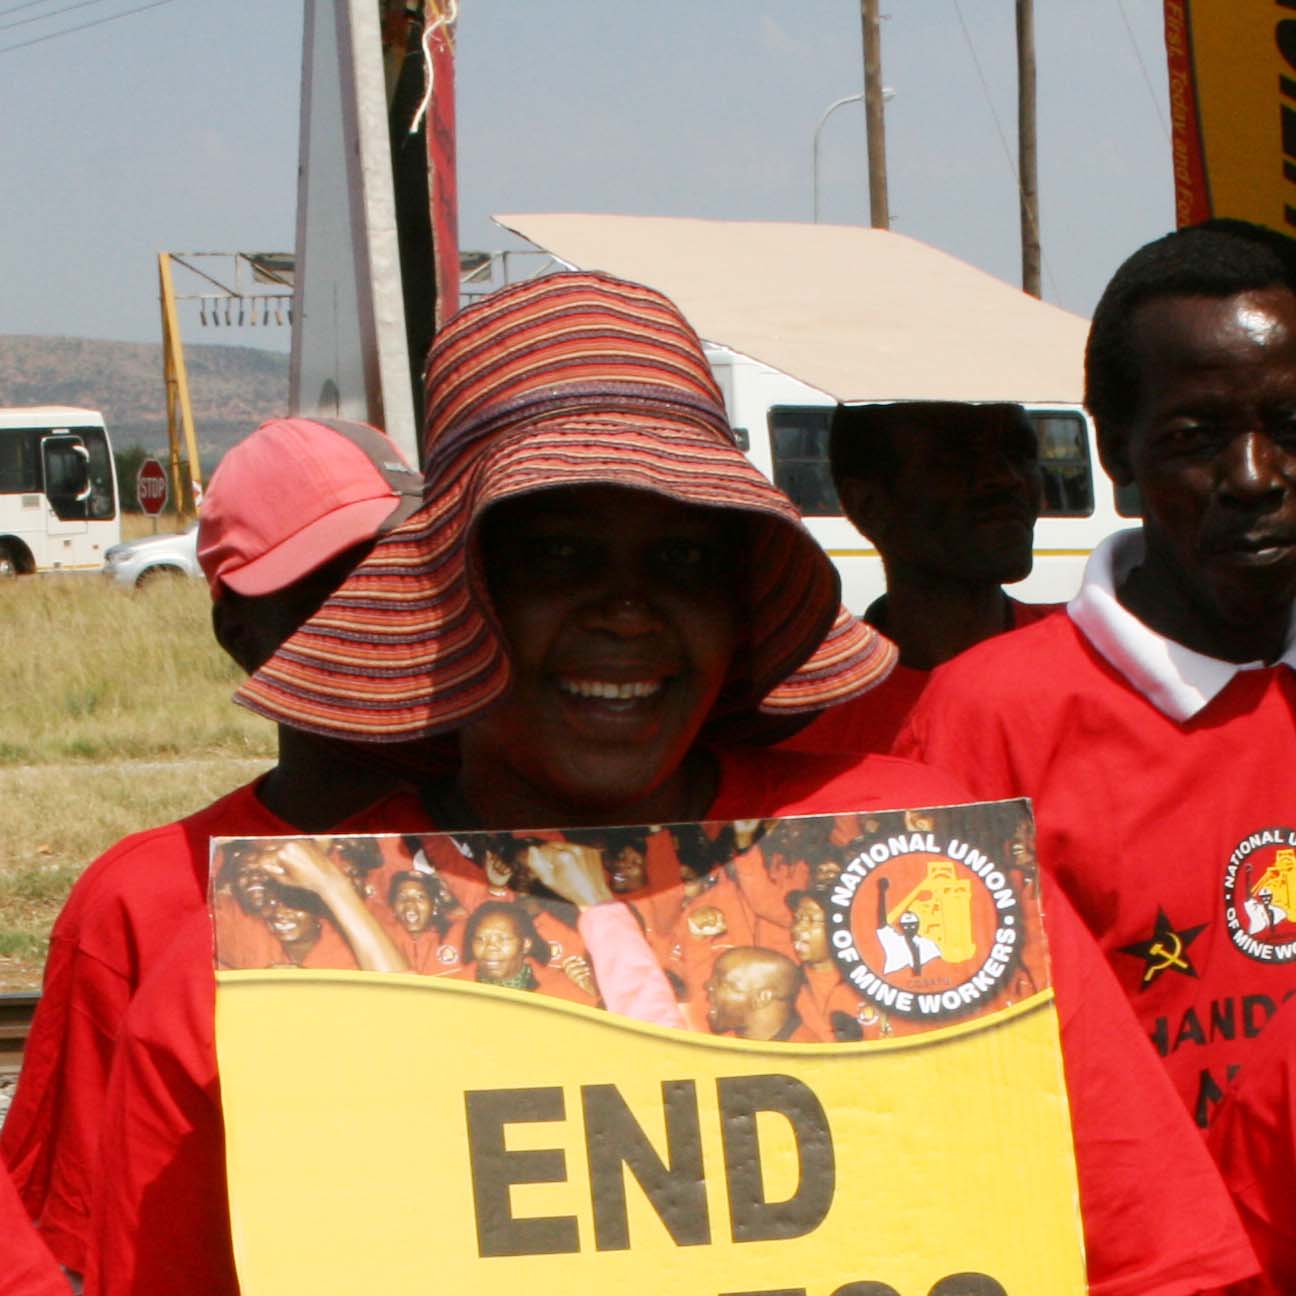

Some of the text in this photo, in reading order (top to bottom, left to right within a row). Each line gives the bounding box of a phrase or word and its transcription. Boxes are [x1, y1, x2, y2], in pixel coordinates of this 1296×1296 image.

[139, 477, 165, 498] STOP
[831, 833, 1016, 909] NATIONAL UNION
[1224, 830, 1284, 888] NATIONAL
[1226, 907, 1240, 929] OF
[1233, 930, 1273, 960] MINE
[832, 928, 1016, 1013] OF MINE WORKERS
[463, 1073, 836, 1258] END
